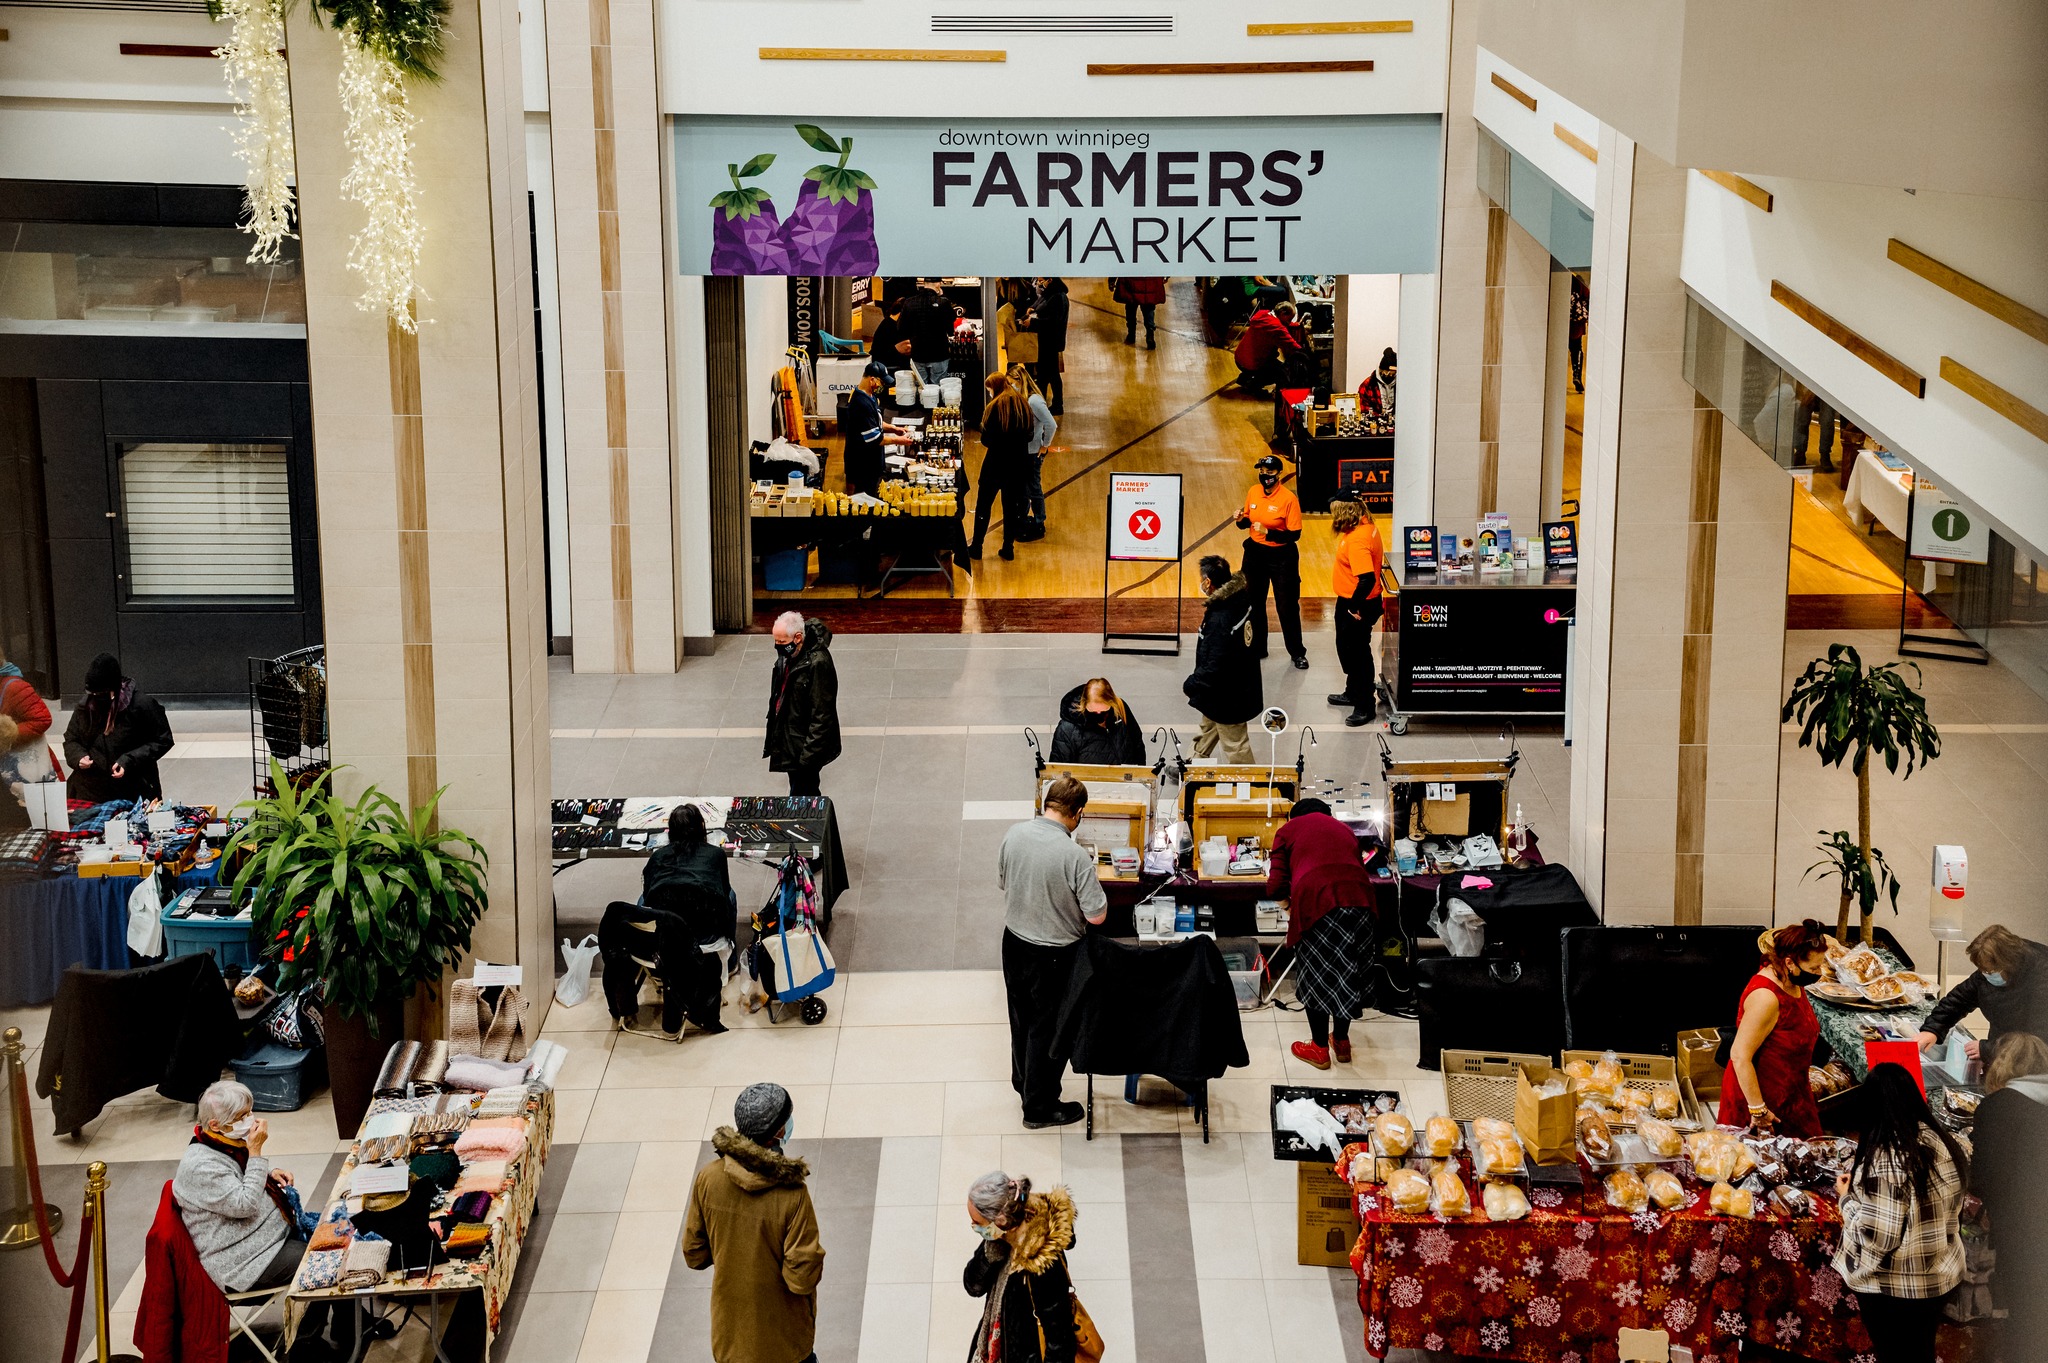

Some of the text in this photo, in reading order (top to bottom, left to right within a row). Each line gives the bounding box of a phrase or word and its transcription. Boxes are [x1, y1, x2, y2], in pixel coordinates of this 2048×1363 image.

[938, 129, 1150, 149] downtown winnipeg
[1027, 216, 1302, 264] MARKET
[828, 384, 856, 394] GILDAN
[1352, 470, 1390, 484] PAT
[1413, 613, 1448, 622] TOWN
